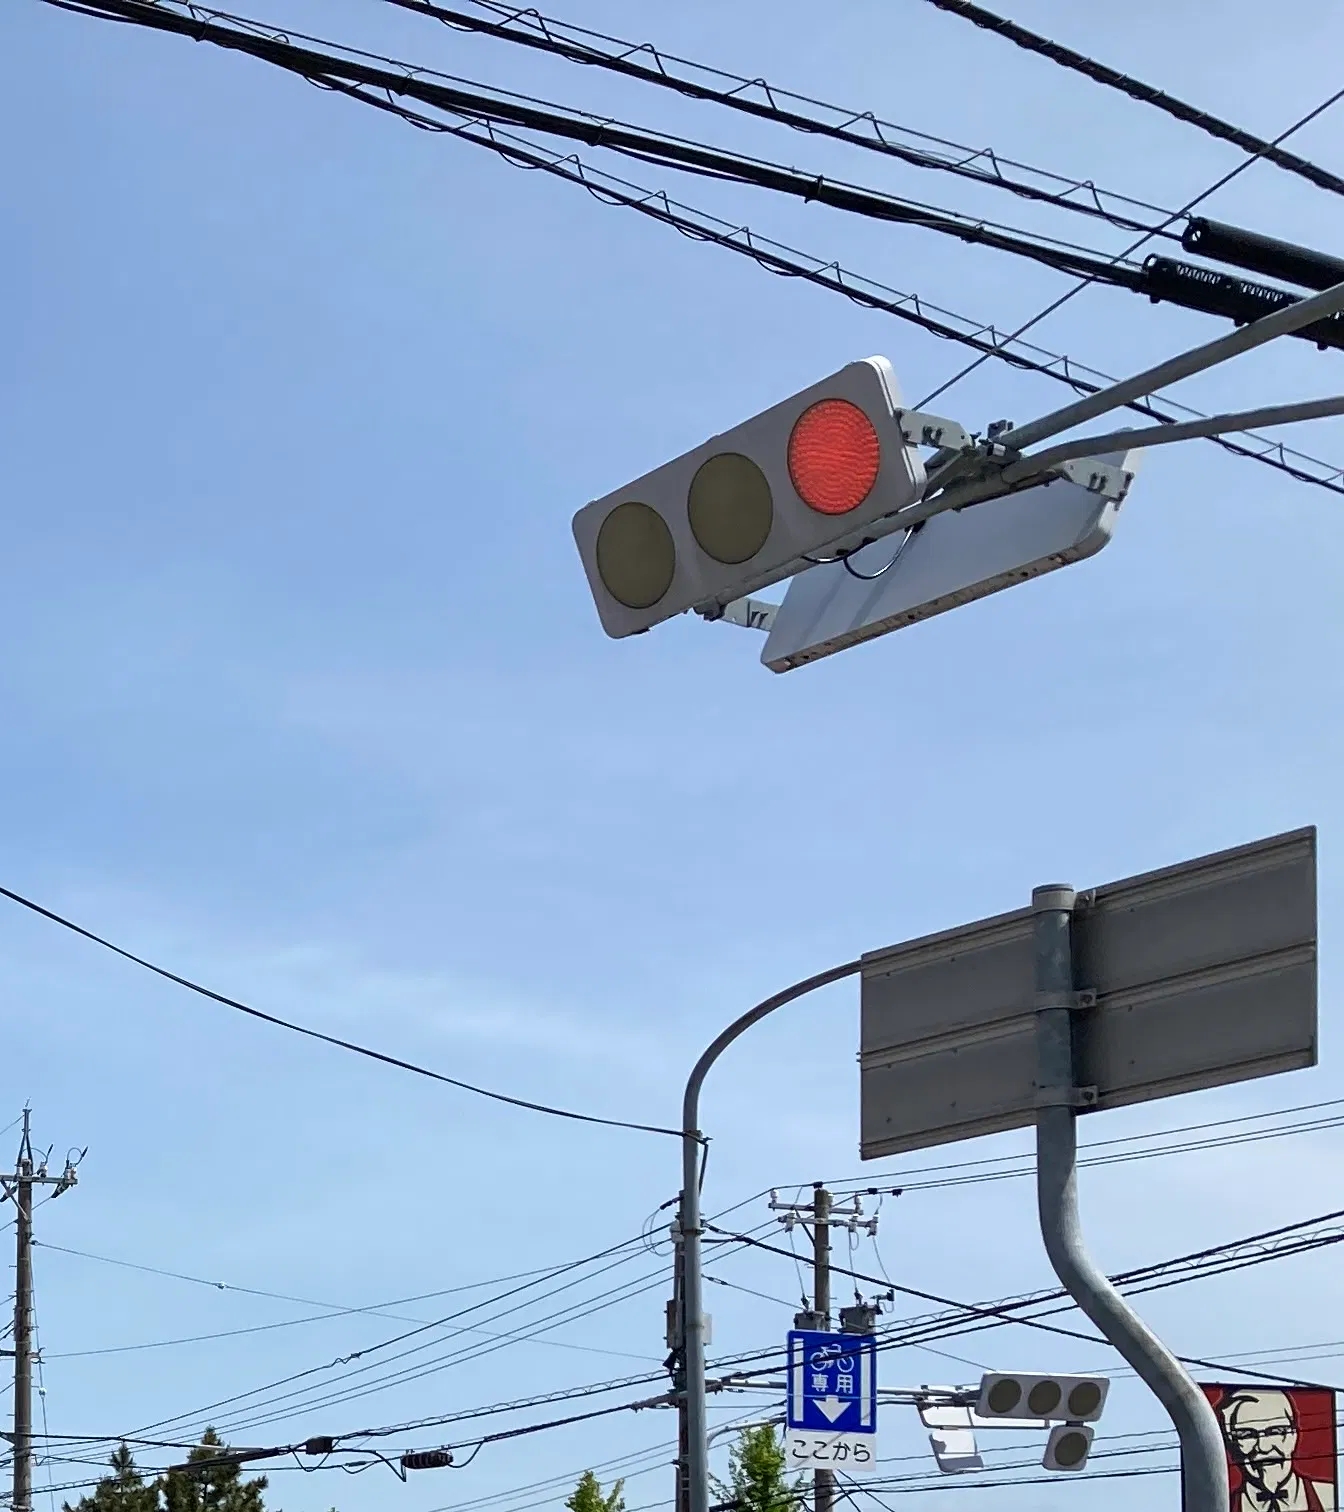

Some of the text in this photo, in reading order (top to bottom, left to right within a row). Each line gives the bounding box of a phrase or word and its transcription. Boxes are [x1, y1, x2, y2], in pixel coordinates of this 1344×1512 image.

[811, 1373, 854, 1394] 専用
[792, 1439, 871, 1463] ここから
